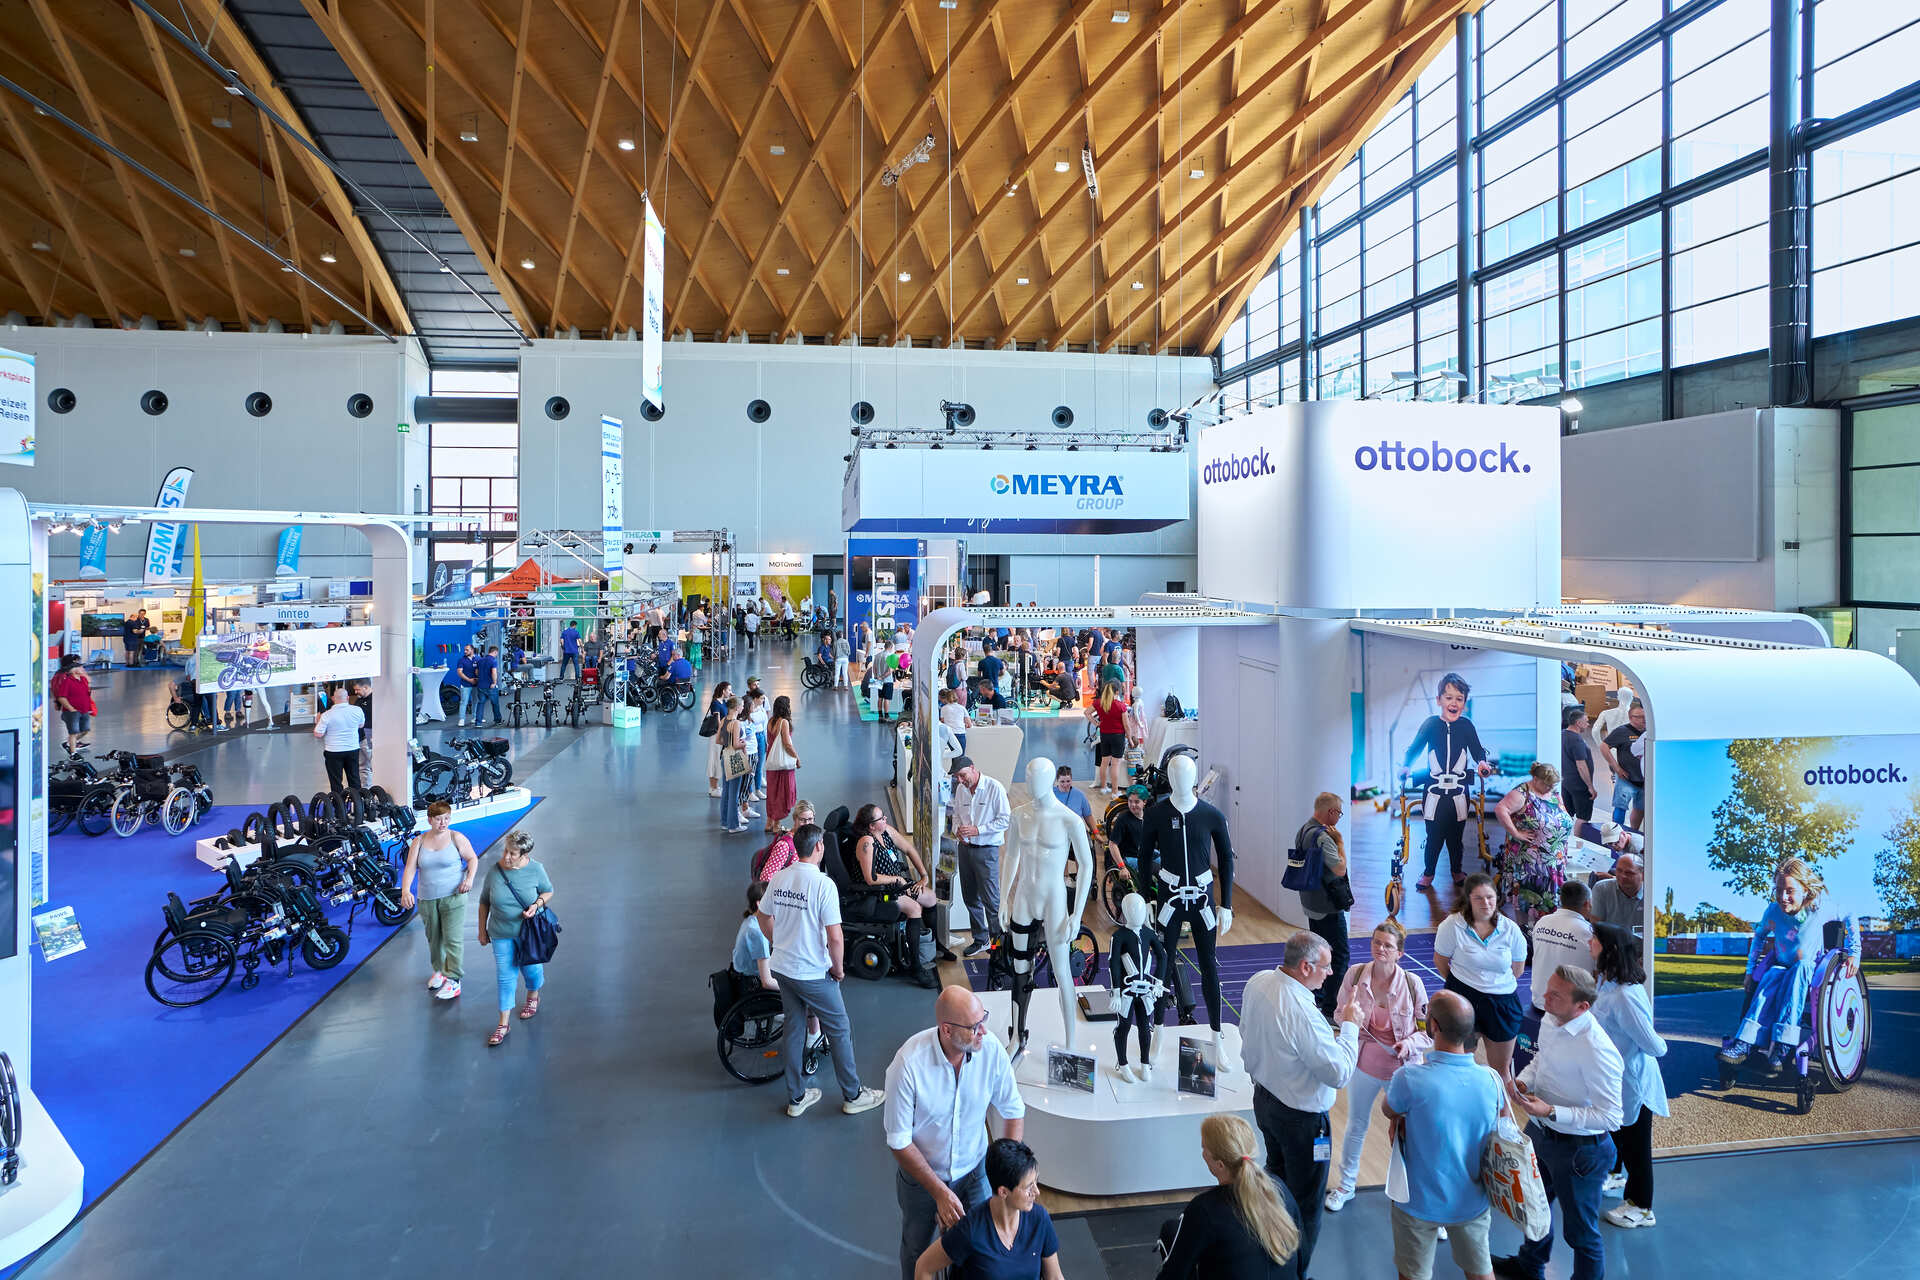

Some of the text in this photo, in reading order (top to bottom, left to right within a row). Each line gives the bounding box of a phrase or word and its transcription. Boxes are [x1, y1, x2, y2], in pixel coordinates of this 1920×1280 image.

[1203, 446, 1276, 485] ottobock.
[1354, 440, 1531, 473] ottobock.
[1012, 474, 1123, 495] MEYRA
[1076, 498, 1123, 510] GROUP
[327, 640, 373, 654] PAWS
[1804, 763, 1908, 786] ottobock.
[773, 889, 808, 902] ottobock.
[1536, 926, 1578, 943] ottobock.
